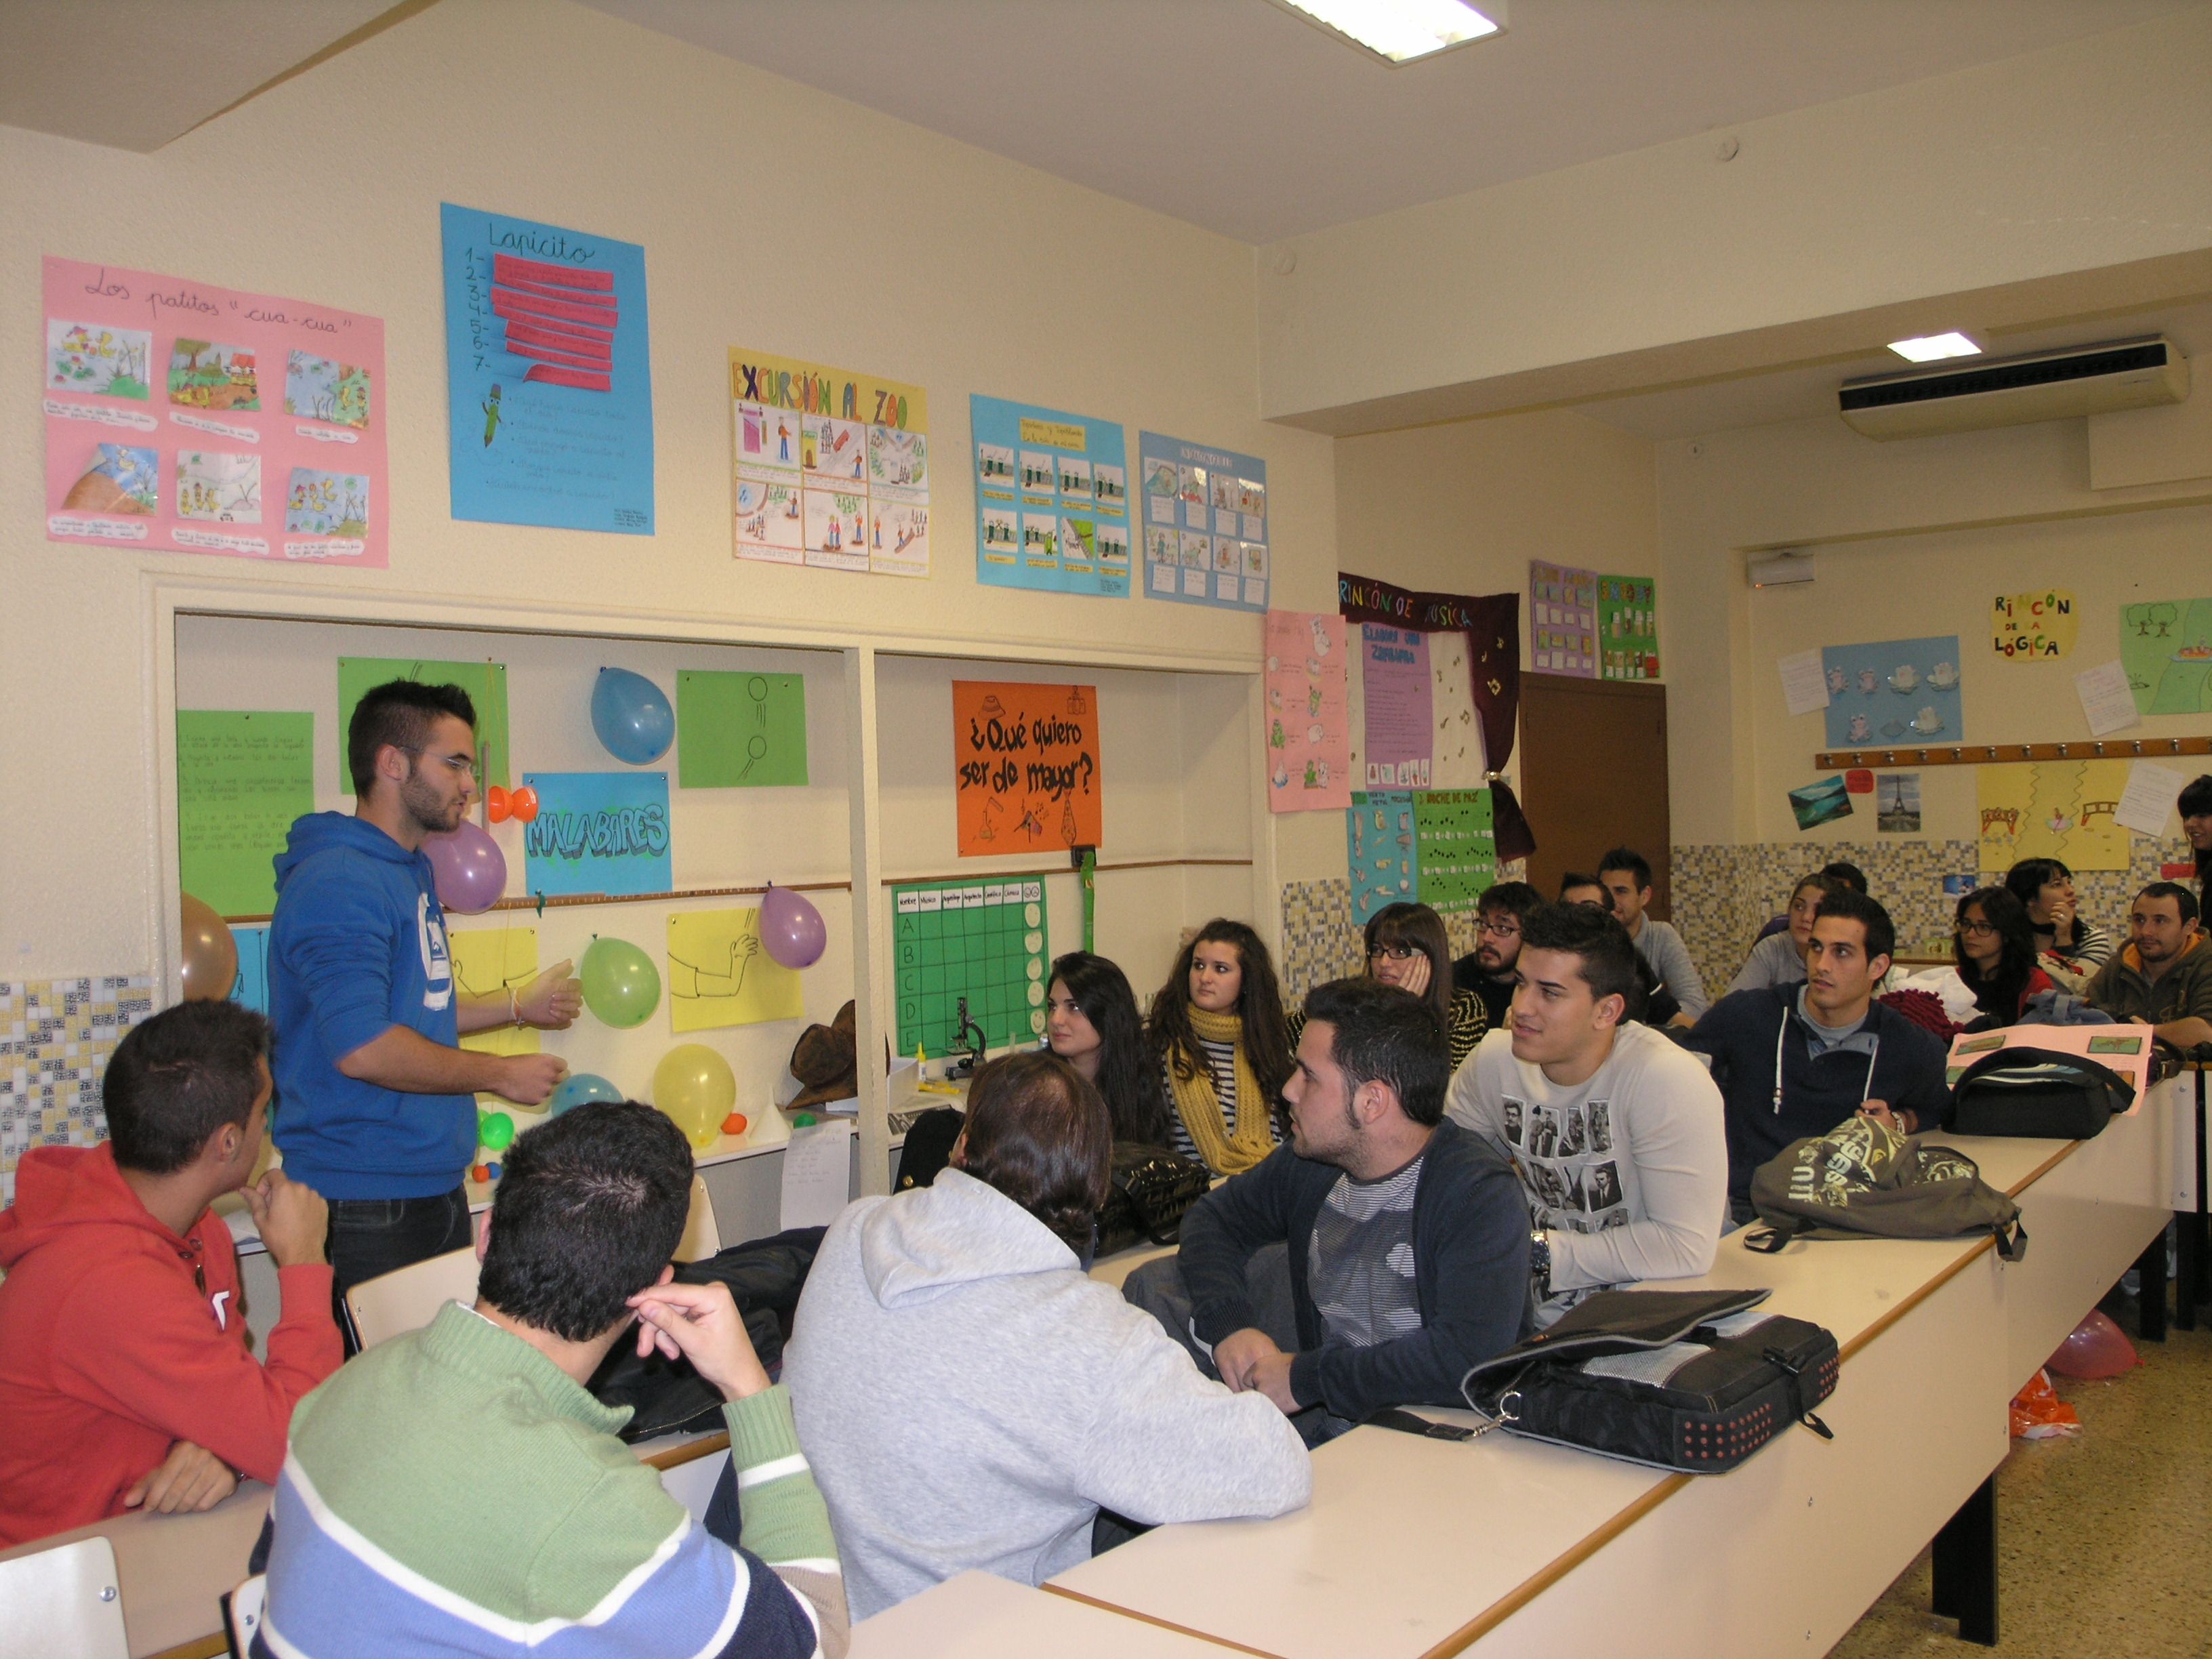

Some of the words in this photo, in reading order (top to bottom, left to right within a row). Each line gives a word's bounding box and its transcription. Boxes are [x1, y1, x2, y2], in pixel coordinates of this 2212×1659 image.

[489, 222, 596, 263] Lapicito
[85, 268, 130, 300] Los
[146, 291, 220, 320] patitos
[732, 362, 832, 417] EXCURSIÓN
[842, 382, 863, 422] AL
[873, 389, 908, 430] ZOO
[1338, 579, 1393, 613] RINCÓN
[1395, 597, 1414, 618] DE
[2005, 622, 2018, 631] DE
[970, 711, 1028, 753] ¿Qué
[1032, 714, 1083, 756] quiero
[959, 760, 990, 791] ser
[991, 756, 1019, 794] de
[1026, 751, 1094, 803] mayor?
[1427, 792, 1451, 805] NOCHE
[1452, 793, 1462, 804] DE
[1462, 790, 1480, 804] PAZ
[526, 804, 670, 860] MALABARES
[901, 918, 915, 934] A
[903, 946, 914, 964] B
[905, 974, 914, 991] C
[905, 1002, 916, 1021] D
[905, 1030, 916, 1048] E
